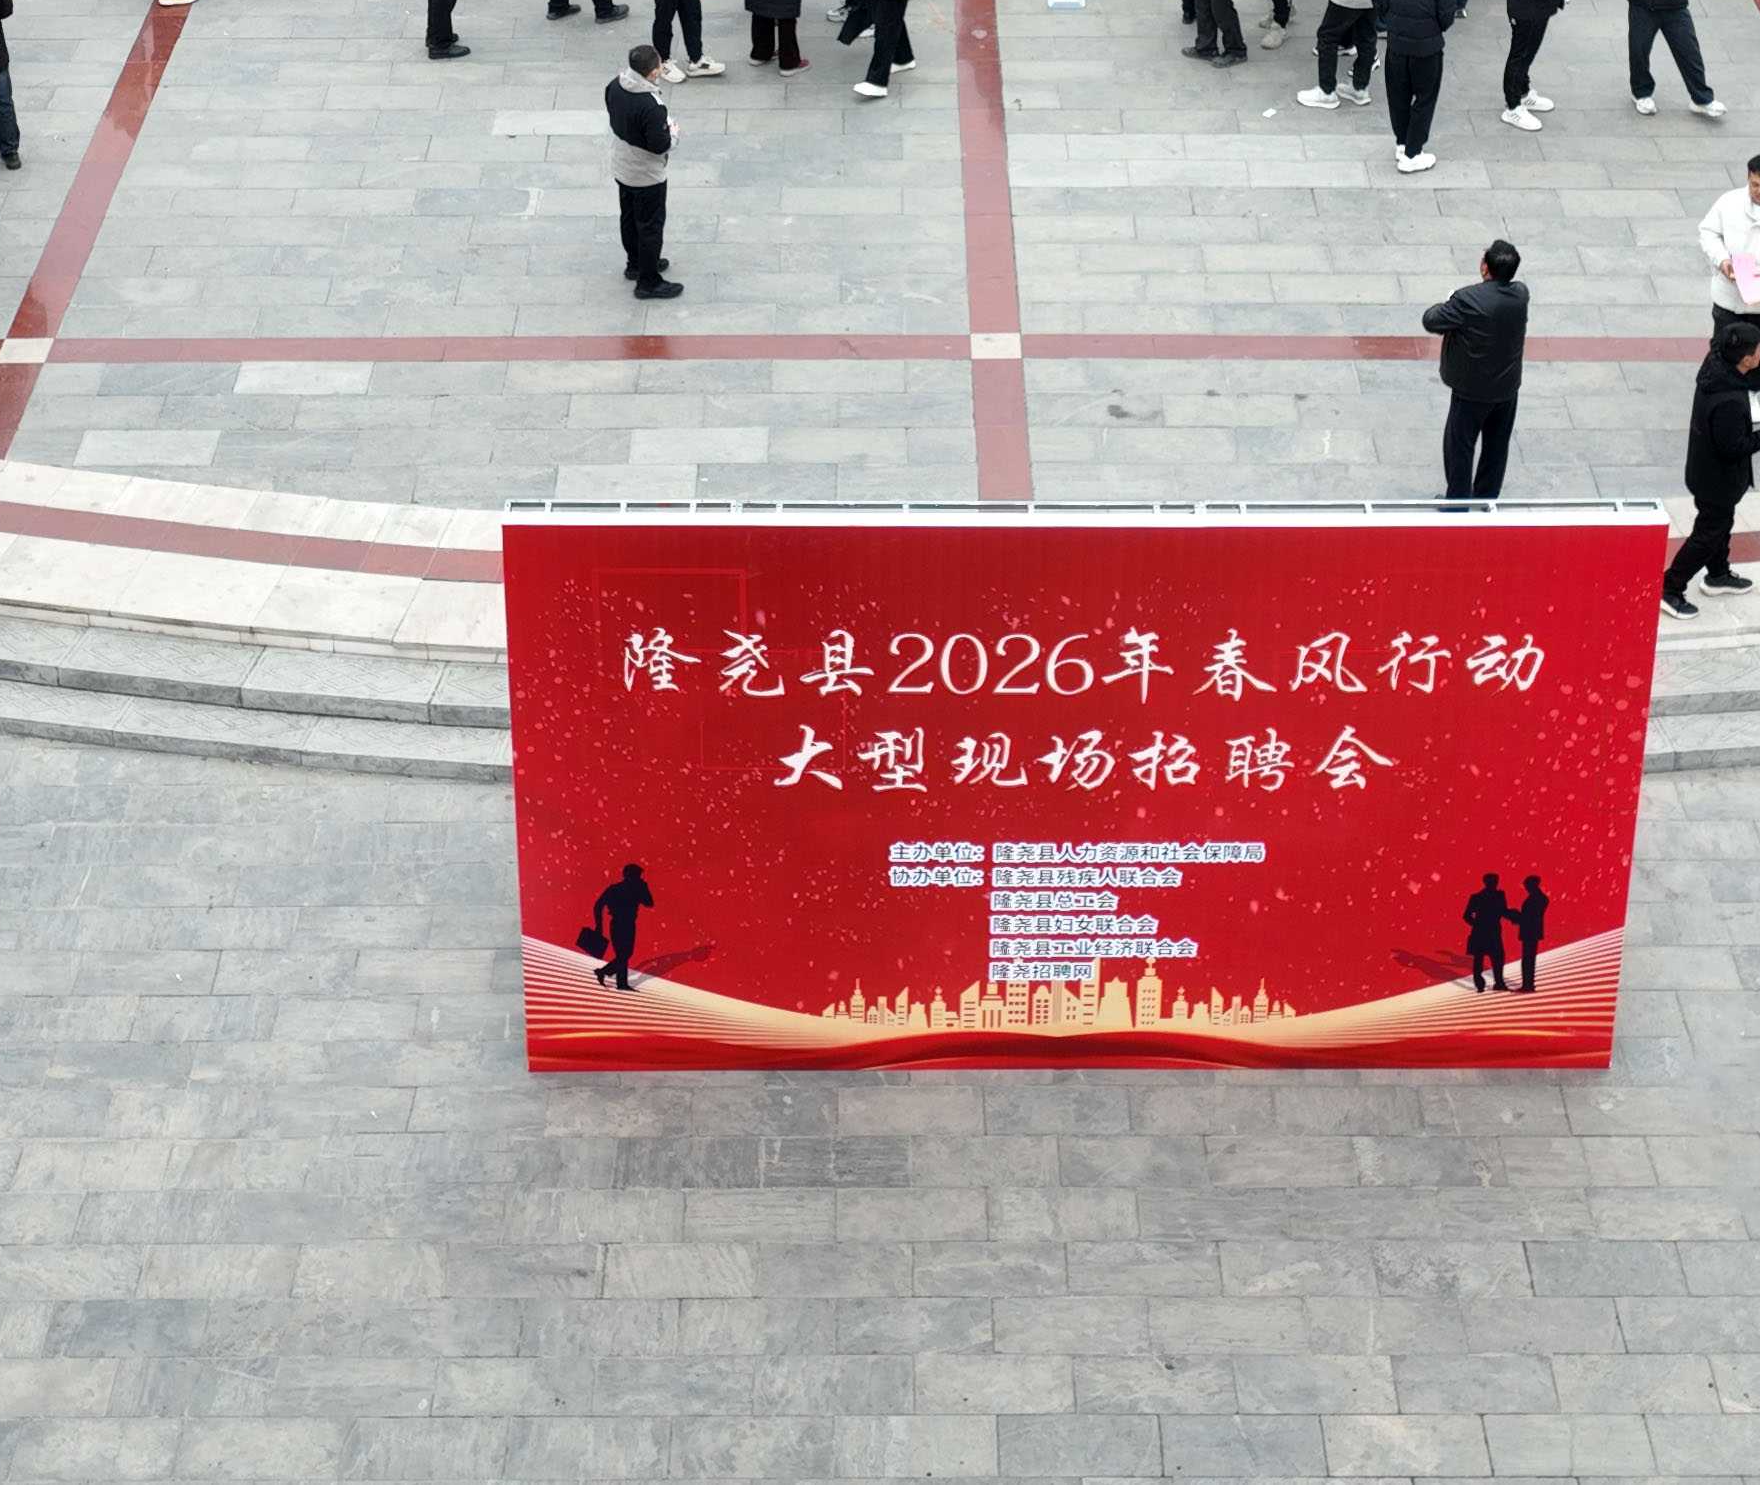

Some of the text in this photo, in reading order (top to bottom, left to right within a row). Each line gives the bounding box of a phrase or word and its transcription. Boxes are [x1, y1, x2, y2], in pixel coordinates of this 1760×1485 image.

[622, 627, 1545, 704] 隆尧县2026年春风行动
[771, 724, 1398, 794] 大型现场招聘会
[992, 892, 1118, 910] 隆尧县总工会
[992, 916, 1158, 933] 隆尧县妇女联合会
[991, 940, 1197, 957] 隆尧县工业经济联合会
[990, 963, 1093, 980] 隆尧招聘网
